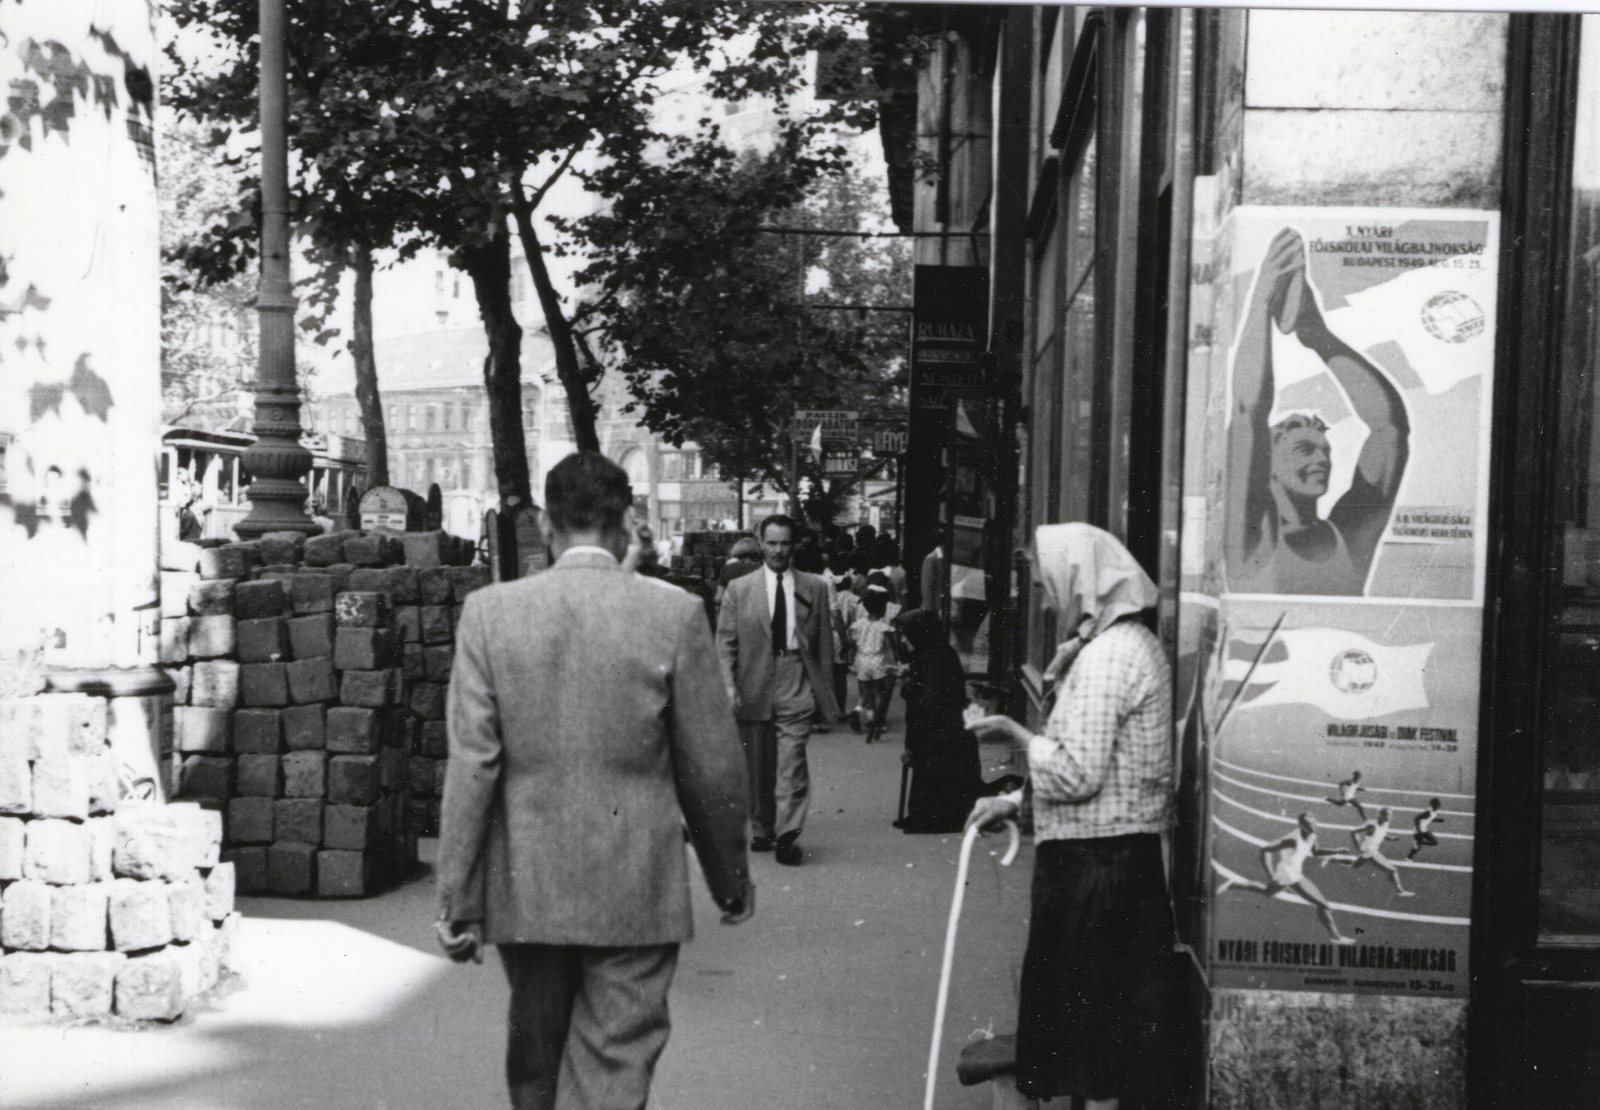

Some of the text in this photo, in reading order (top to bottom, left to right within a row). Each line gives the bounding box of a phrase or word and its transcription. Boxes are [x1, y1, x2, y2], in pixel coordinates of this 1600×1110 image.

[1343, 257, 1396, 268] BUDAPEST
[1218, 939, 1257, 962] NYÁRI
[1338, 944, 1456, 972] VILÁGBAJNOKSÁG
